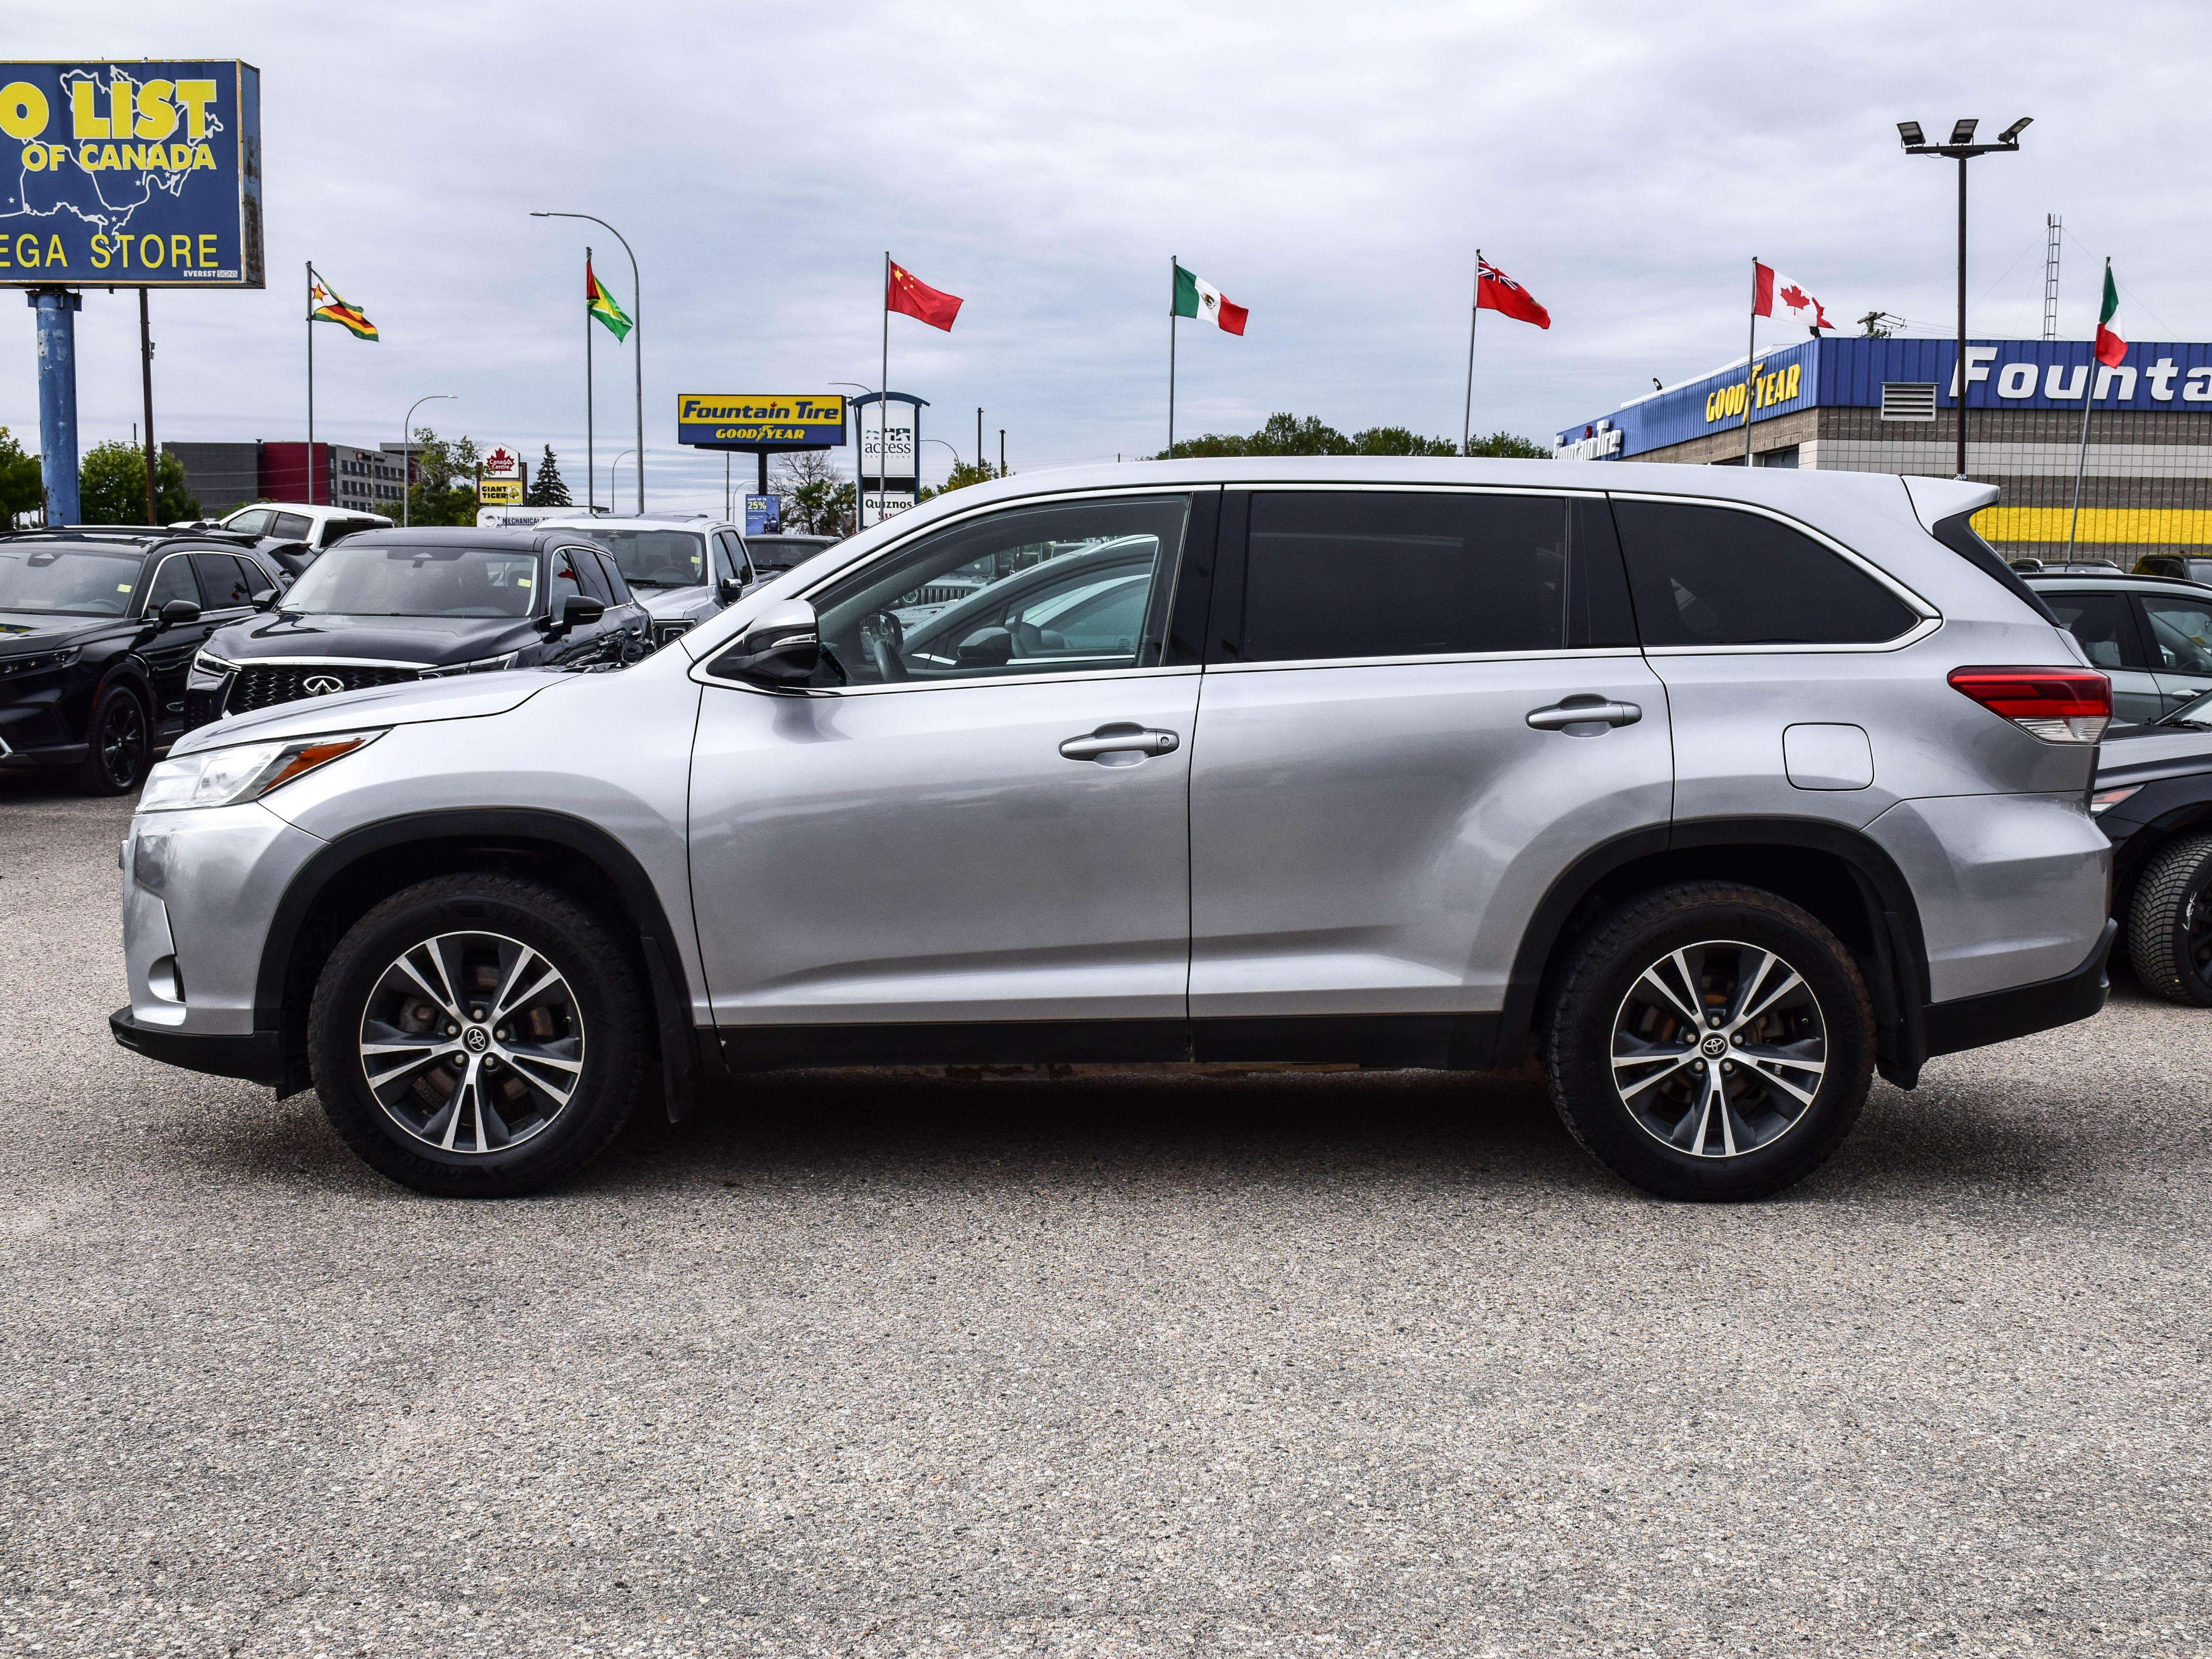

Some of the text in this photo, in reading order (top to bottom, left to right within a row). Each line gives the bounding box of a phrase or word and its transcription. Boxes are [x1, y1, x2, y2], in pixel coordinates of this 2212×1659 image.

[72, 79, 216, 139] LIST
[22, 144, 216, 171] OF CANADA
[91, 234, 219, 268] STORE
[1706, 364, 1801, 423] GOODYEAR
[682, 400, 839, 420] Fountain Tire
[715, 428, 805, 440] GOODYEAR
[747, 501, 767, 510] 25%
